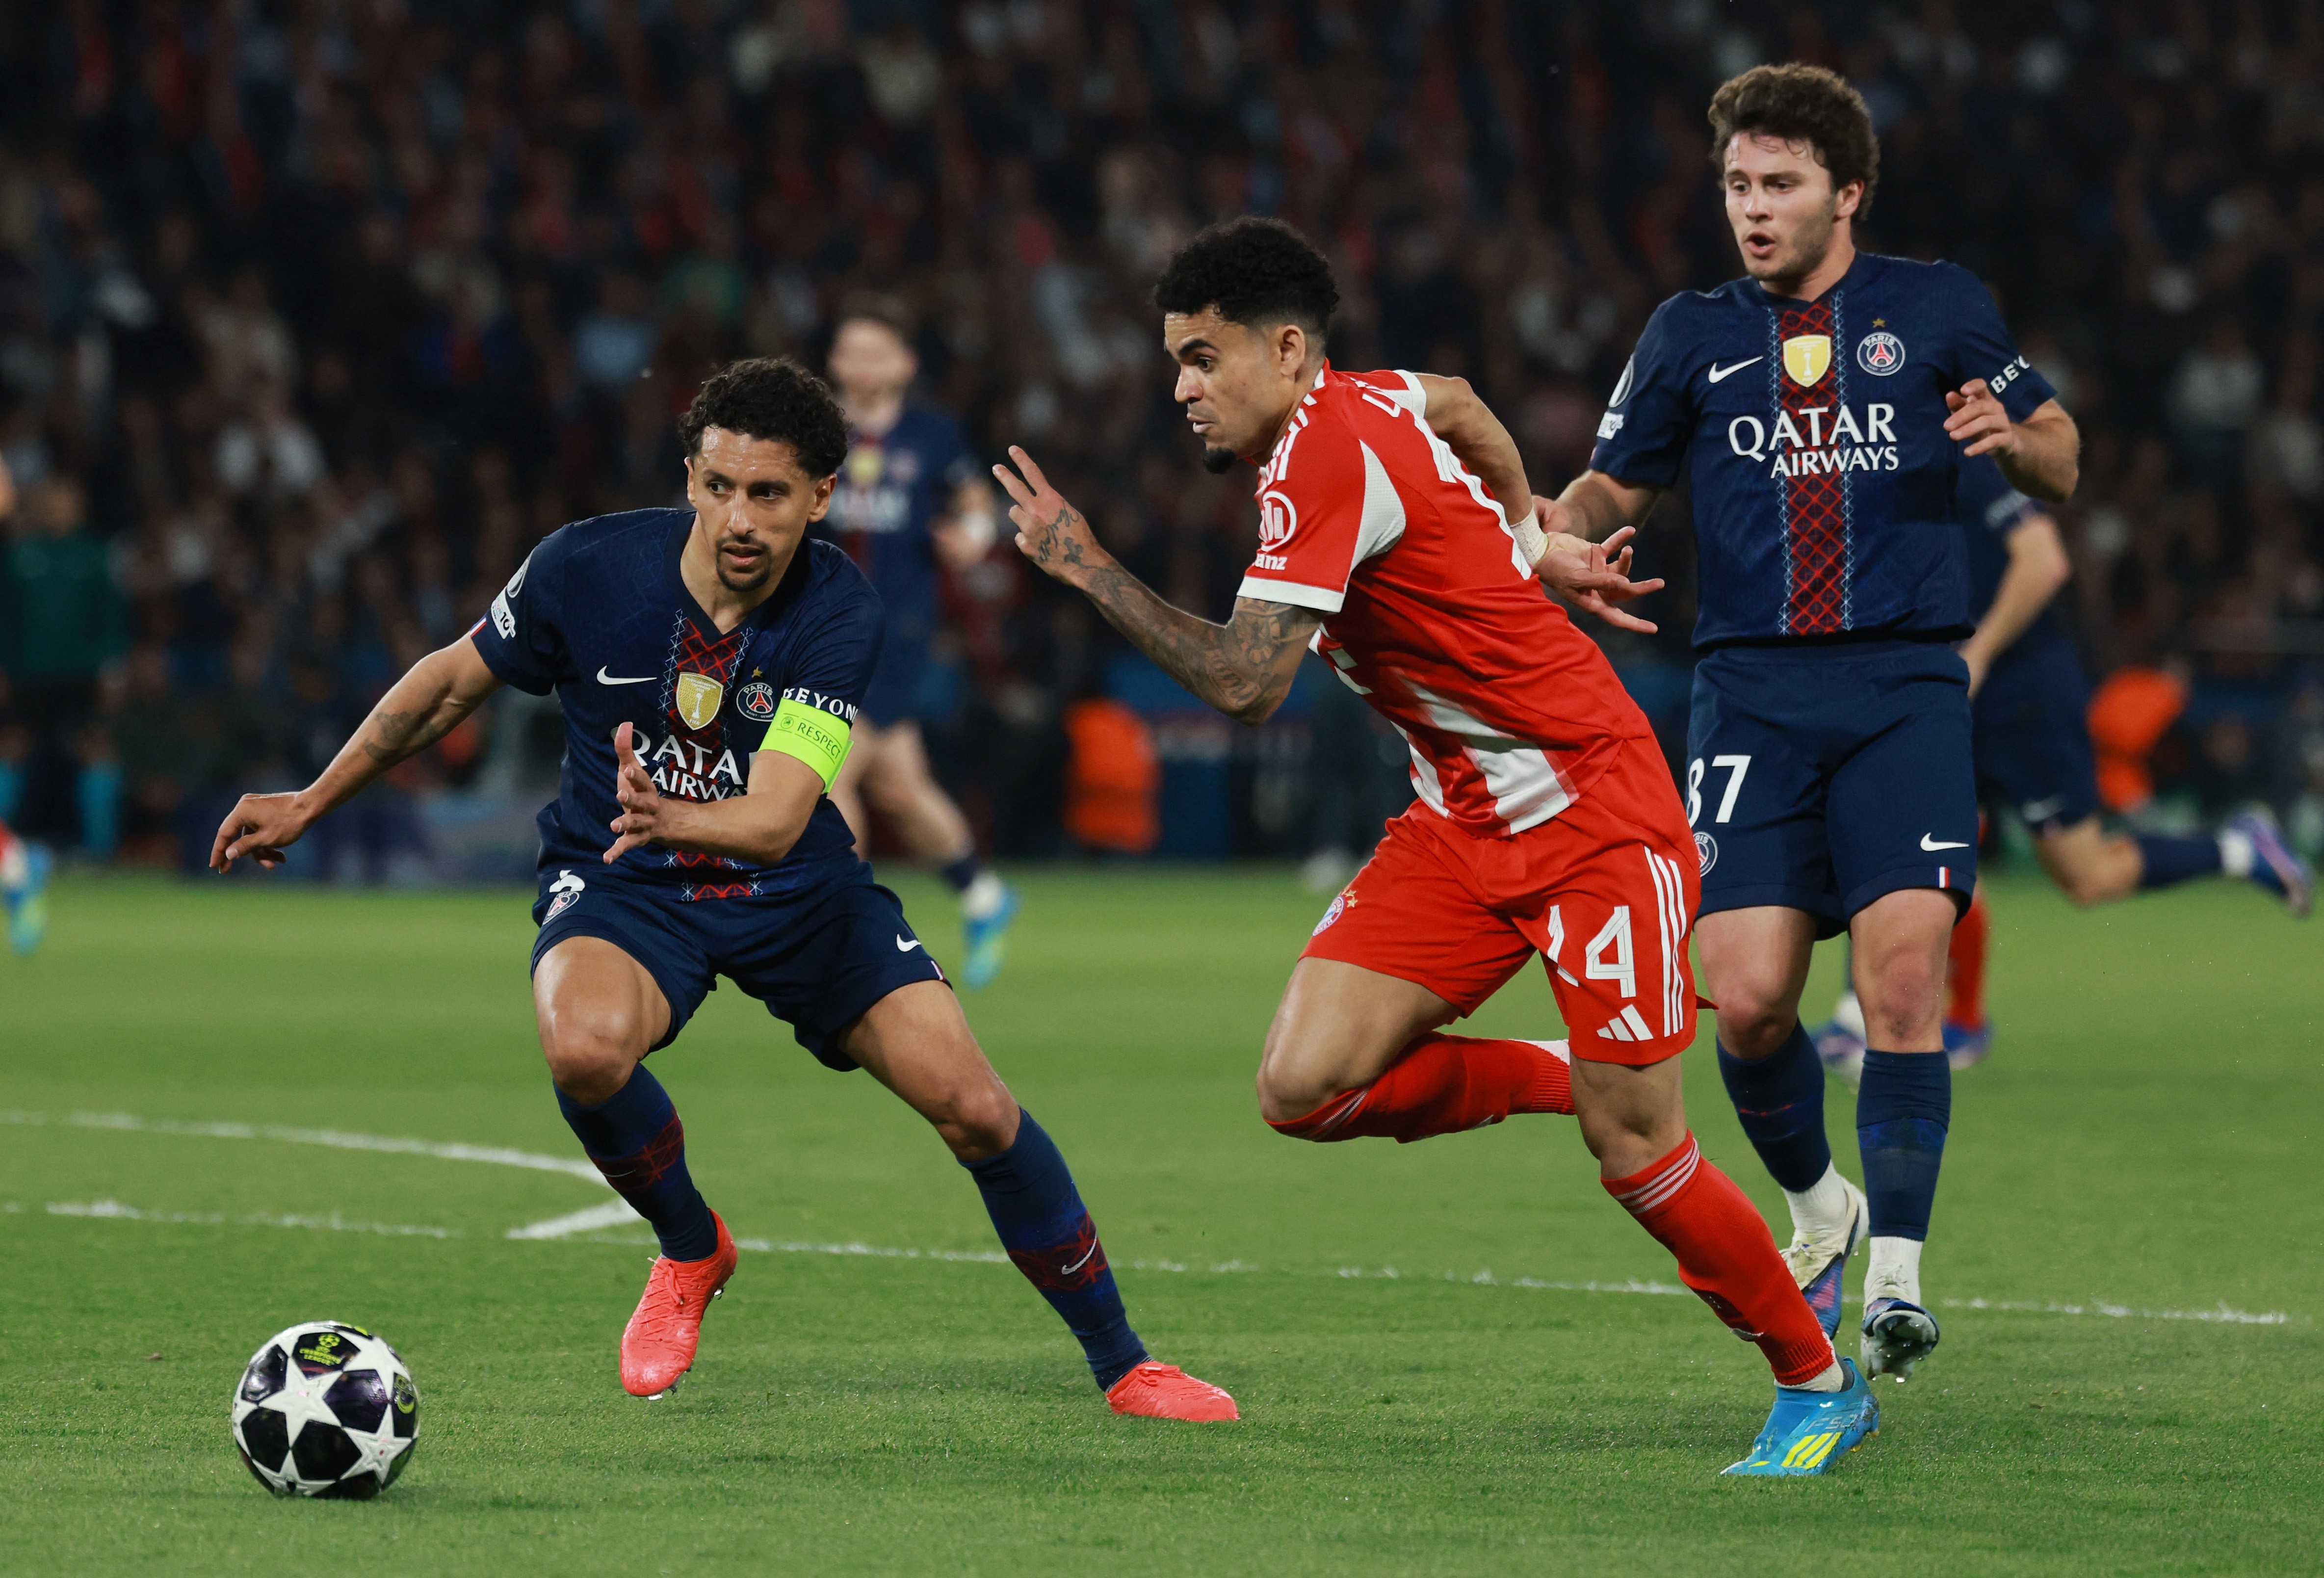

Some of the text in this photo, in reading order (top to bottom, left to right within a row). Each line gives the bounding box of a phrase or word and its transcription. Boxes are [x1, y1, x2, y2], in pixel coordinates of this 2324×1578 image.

[1864, 335, 1895, 346] PARIS
[1728, 403, 1897, 463] QATAR
[1771, 446, 1899, 479] AIRWAYS
[1254, 553, 1288, 571] anz
[743, 684, 773, 696] PARIS
[783, 687, 859, 723] BEYON
[797, 722, 841, 759] RESPECT
